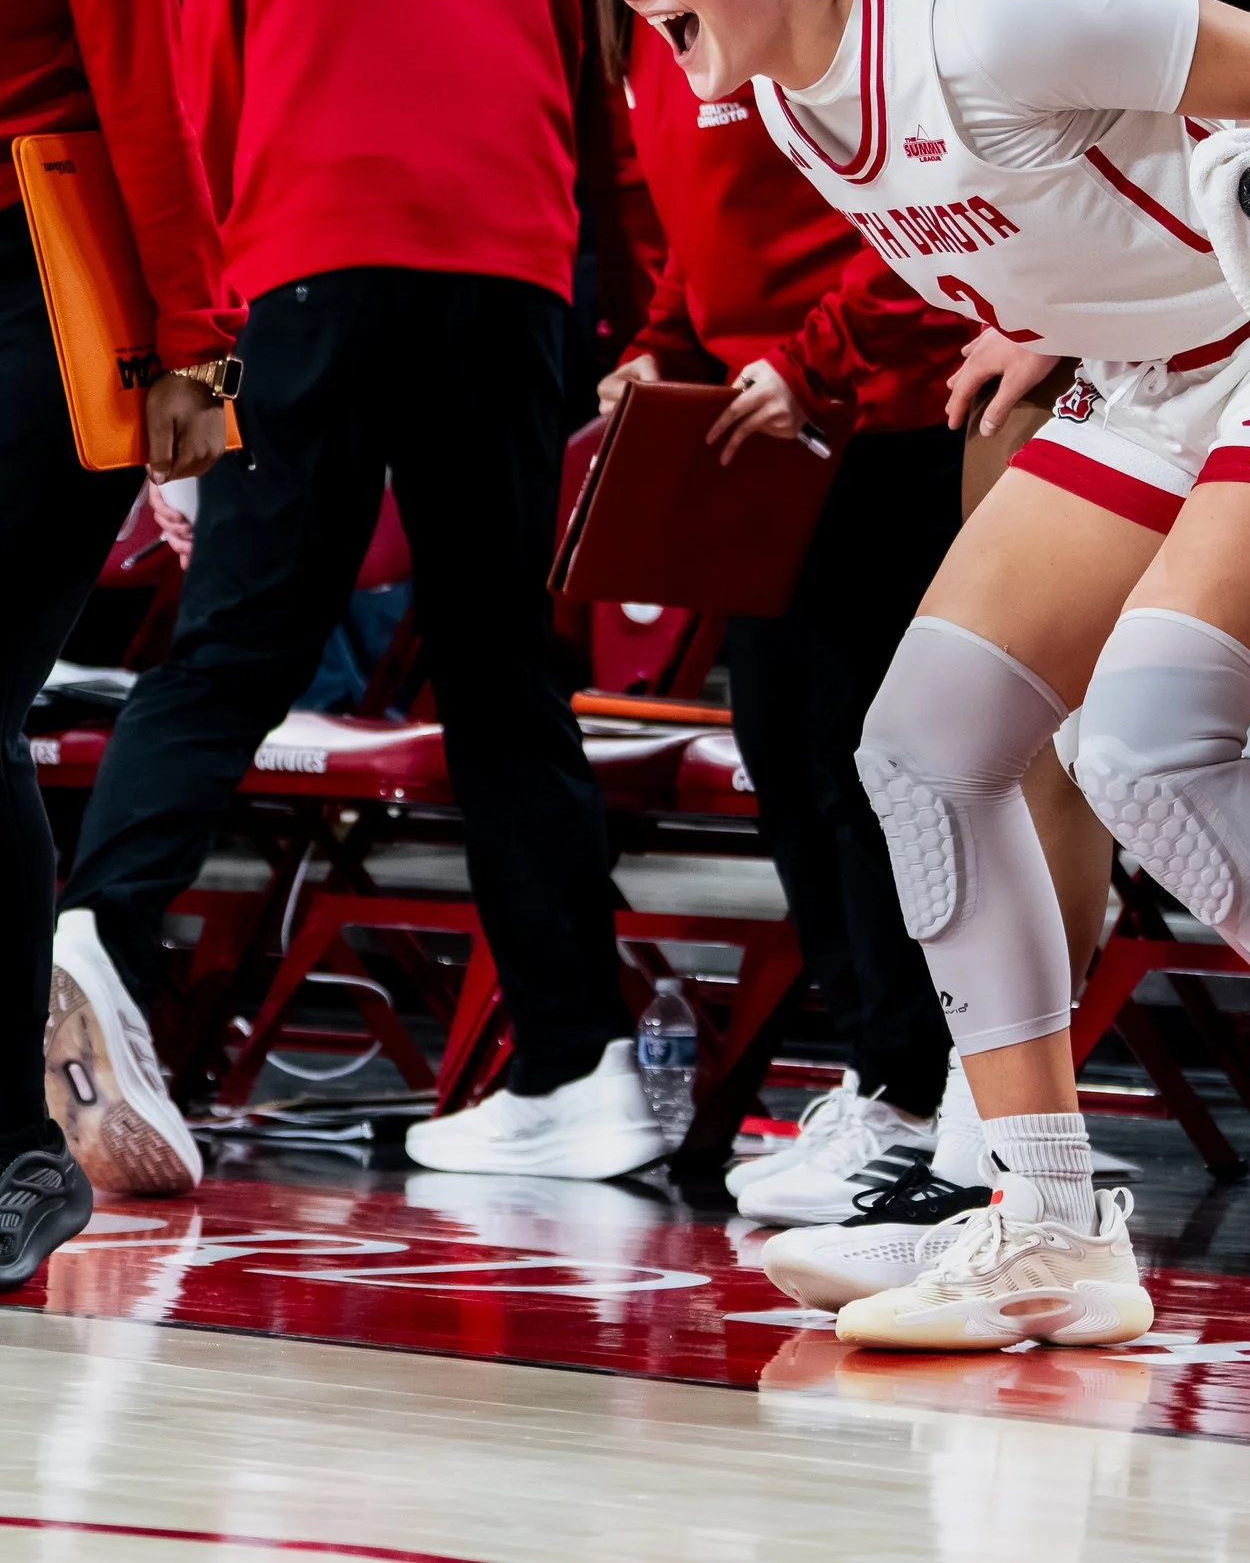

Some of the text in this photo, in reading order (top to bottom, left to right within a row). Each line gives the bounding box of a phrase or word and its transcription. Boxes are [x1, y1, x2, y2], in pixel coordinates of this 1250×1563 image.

[697, 108, 749, 129] DAKOTA
[903, 140, 947, 158] SUMMIT
[887, 195, 1021, 256] DAKOTA
[937, 274, 1046, 344] 2
